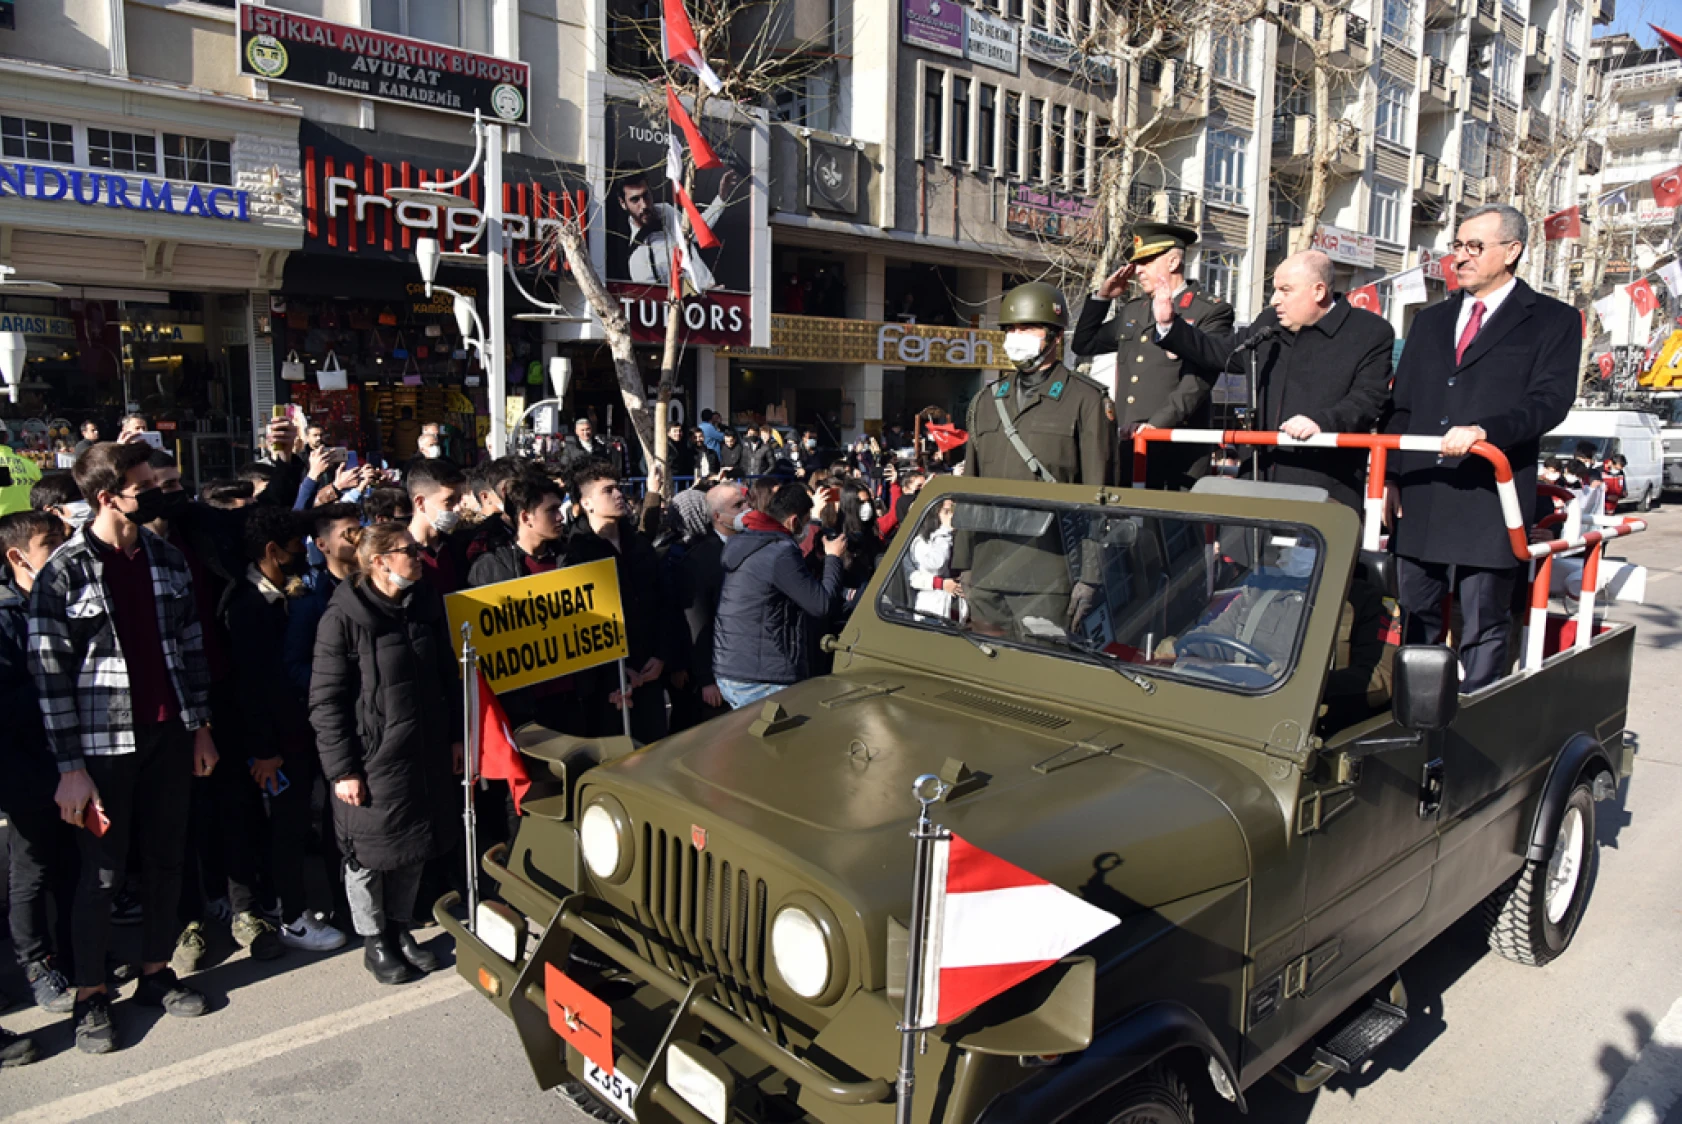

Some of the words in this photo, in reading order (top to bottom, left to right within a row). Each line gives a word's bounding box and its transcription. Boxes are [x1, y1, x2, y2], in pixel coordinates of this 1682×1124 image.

[247, 6, 337, 47] İSTİKLAL
[342, 32, 447, 70] AVUKATLIK
[452, 54, 524, 85] BÜROSU
[327, 71, 370, 91] Duran
[379, 81, 462, 108] KARADEMİR
[351, 56, 441, 86] AVUKAT
[628, 126, 671, 145] TUDOR
[1, 315, 47, 335] ARASI
[479, 583, 595, 637] ONİKİŞUBAT
[478, 636, 559, 681] NADOLU
